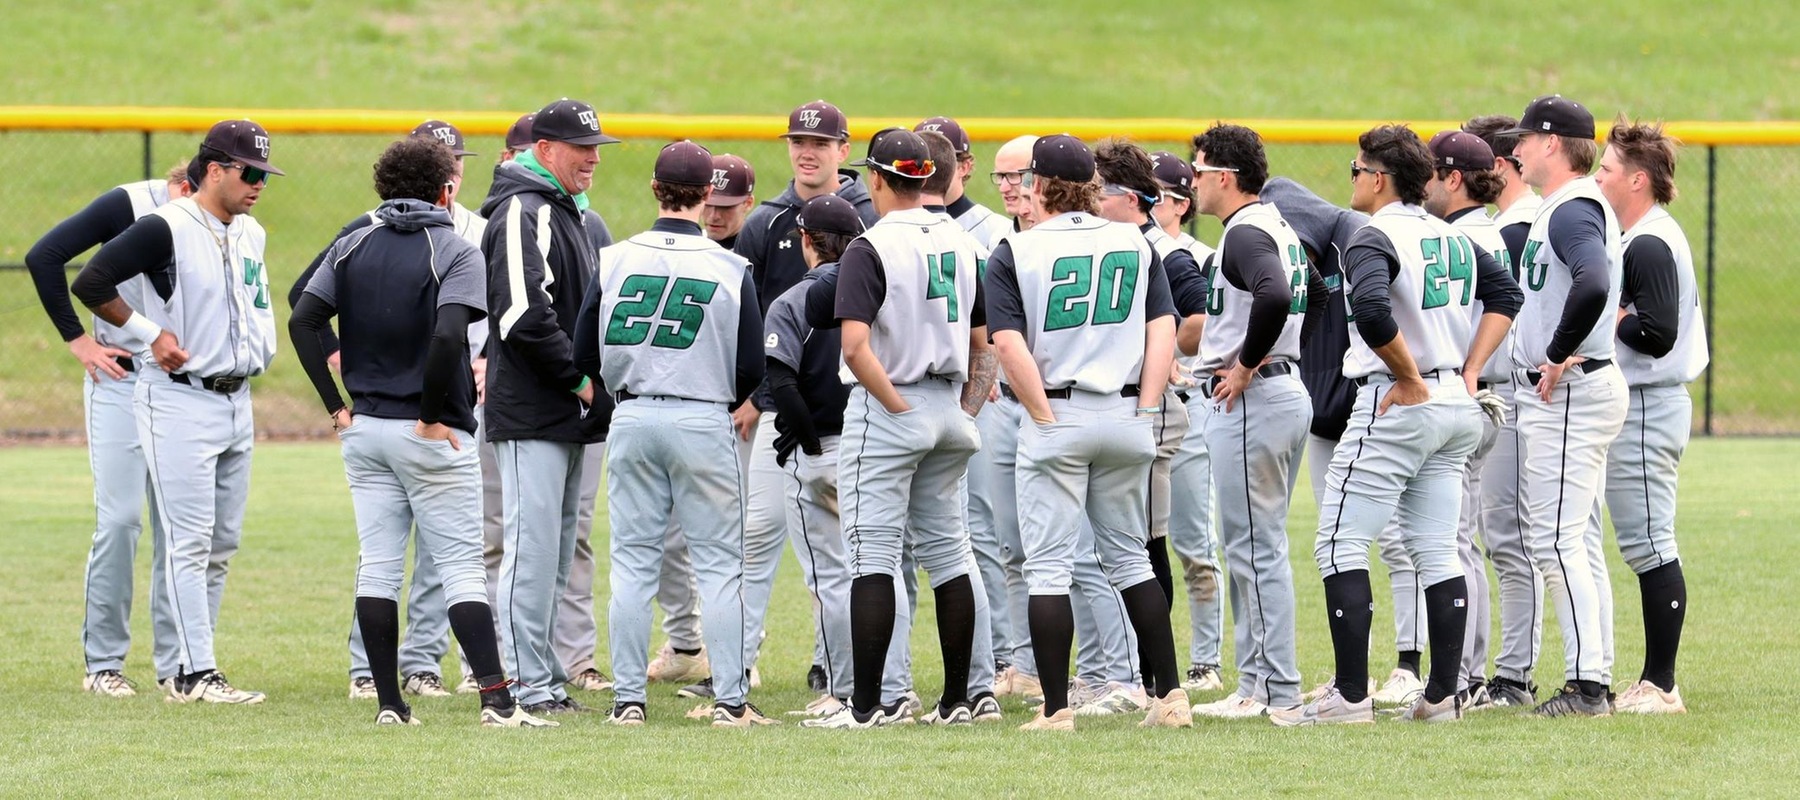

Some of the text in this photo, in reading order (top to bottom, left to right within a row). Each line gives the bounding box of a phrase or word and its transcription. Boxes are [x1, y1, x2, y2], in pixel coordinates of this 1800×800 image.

[432, 127, 456, 146] WU
[577, 110, 600, 131] WU
[797, 109, 822, 129] WU
[923, 123, 944, 134] W
[254, 134, 269, 158] WU
[710, 168, 730, 191] WU
[243, 257, 269, 310] WU
[1420, 236, 1473, 310] 24
[1521, 238, 1549, 292] WU
[926, 250, 959, 323] 4
[1043, 250, 1140, 332] 20
[604, 274, 719, 349] 25
